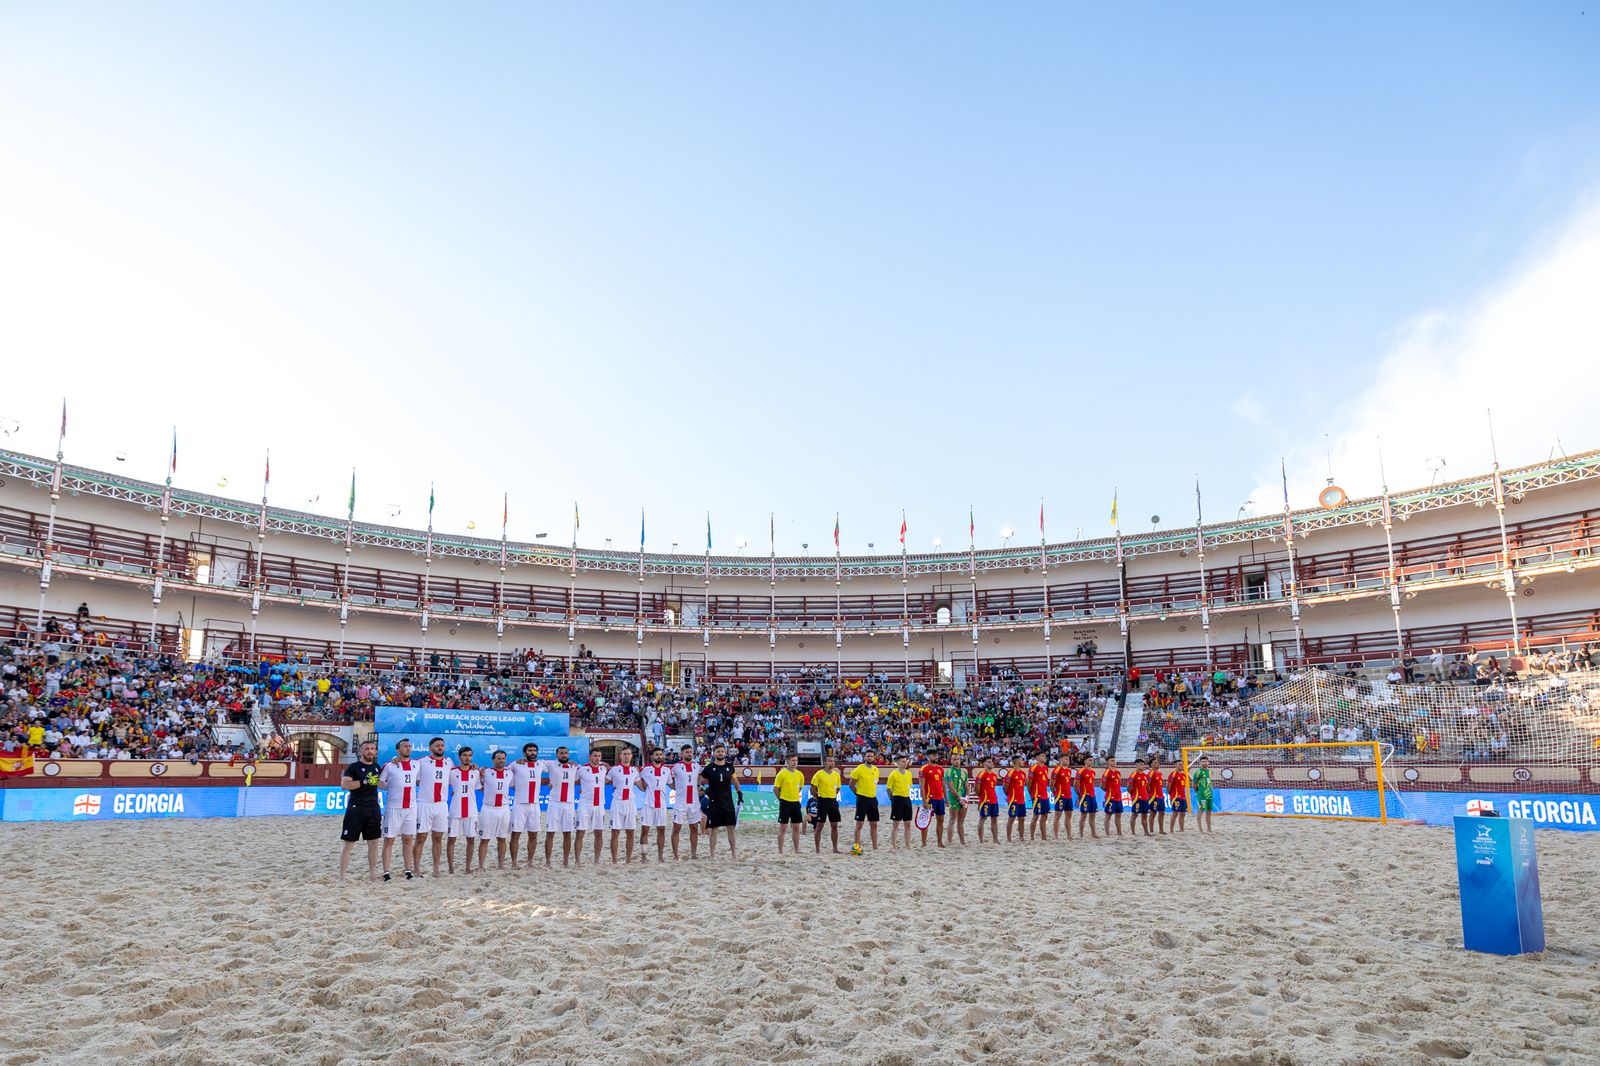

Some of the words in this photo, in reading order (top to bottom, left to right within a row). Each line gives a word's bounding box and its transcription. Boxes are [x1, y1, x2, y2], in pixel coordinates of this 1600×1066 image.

[155, 765, 161, 773] 5
[405, 774, 411, 783] 21
[436, 770, 442, 779] 20
[720, 774, 723, 782] 1
[497, 782, 503, 790] 17
[113, 793, 184, 814] GEORGIA
[1293, 795, 1352, 815] GEORGIA
[1508, 800, 1597, 825] GEORGIA
